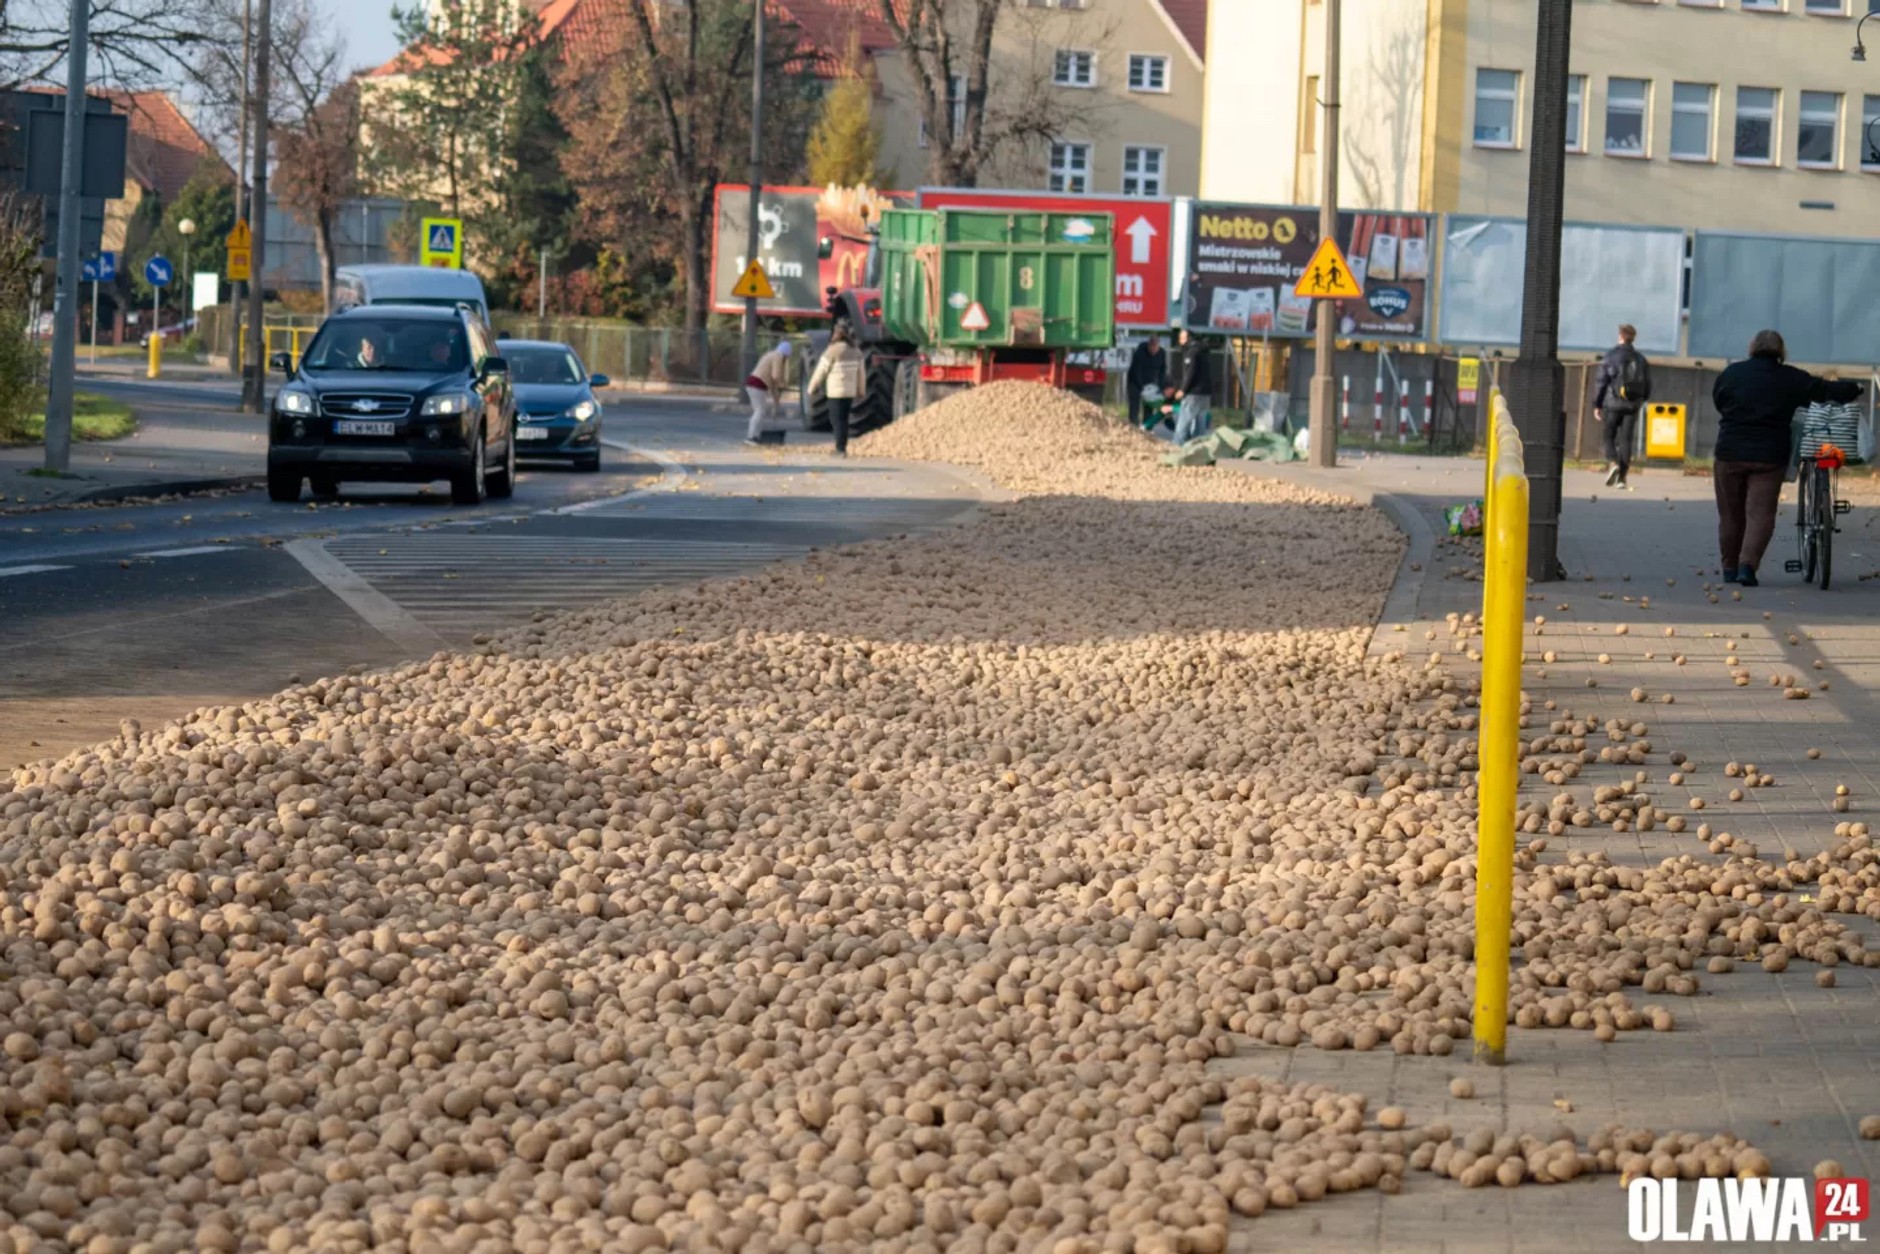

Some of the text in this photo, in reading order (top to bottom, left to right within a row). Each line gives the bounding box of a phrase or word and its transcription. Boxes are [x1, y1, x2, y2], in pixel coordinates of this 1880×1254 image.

[1199, 214, 1269, 240] Netto
[1198, 244, 1282, 260] Mistrzowskie
[767, 256, 803, 278] km
[1019, 266, 1034, 290] 8
